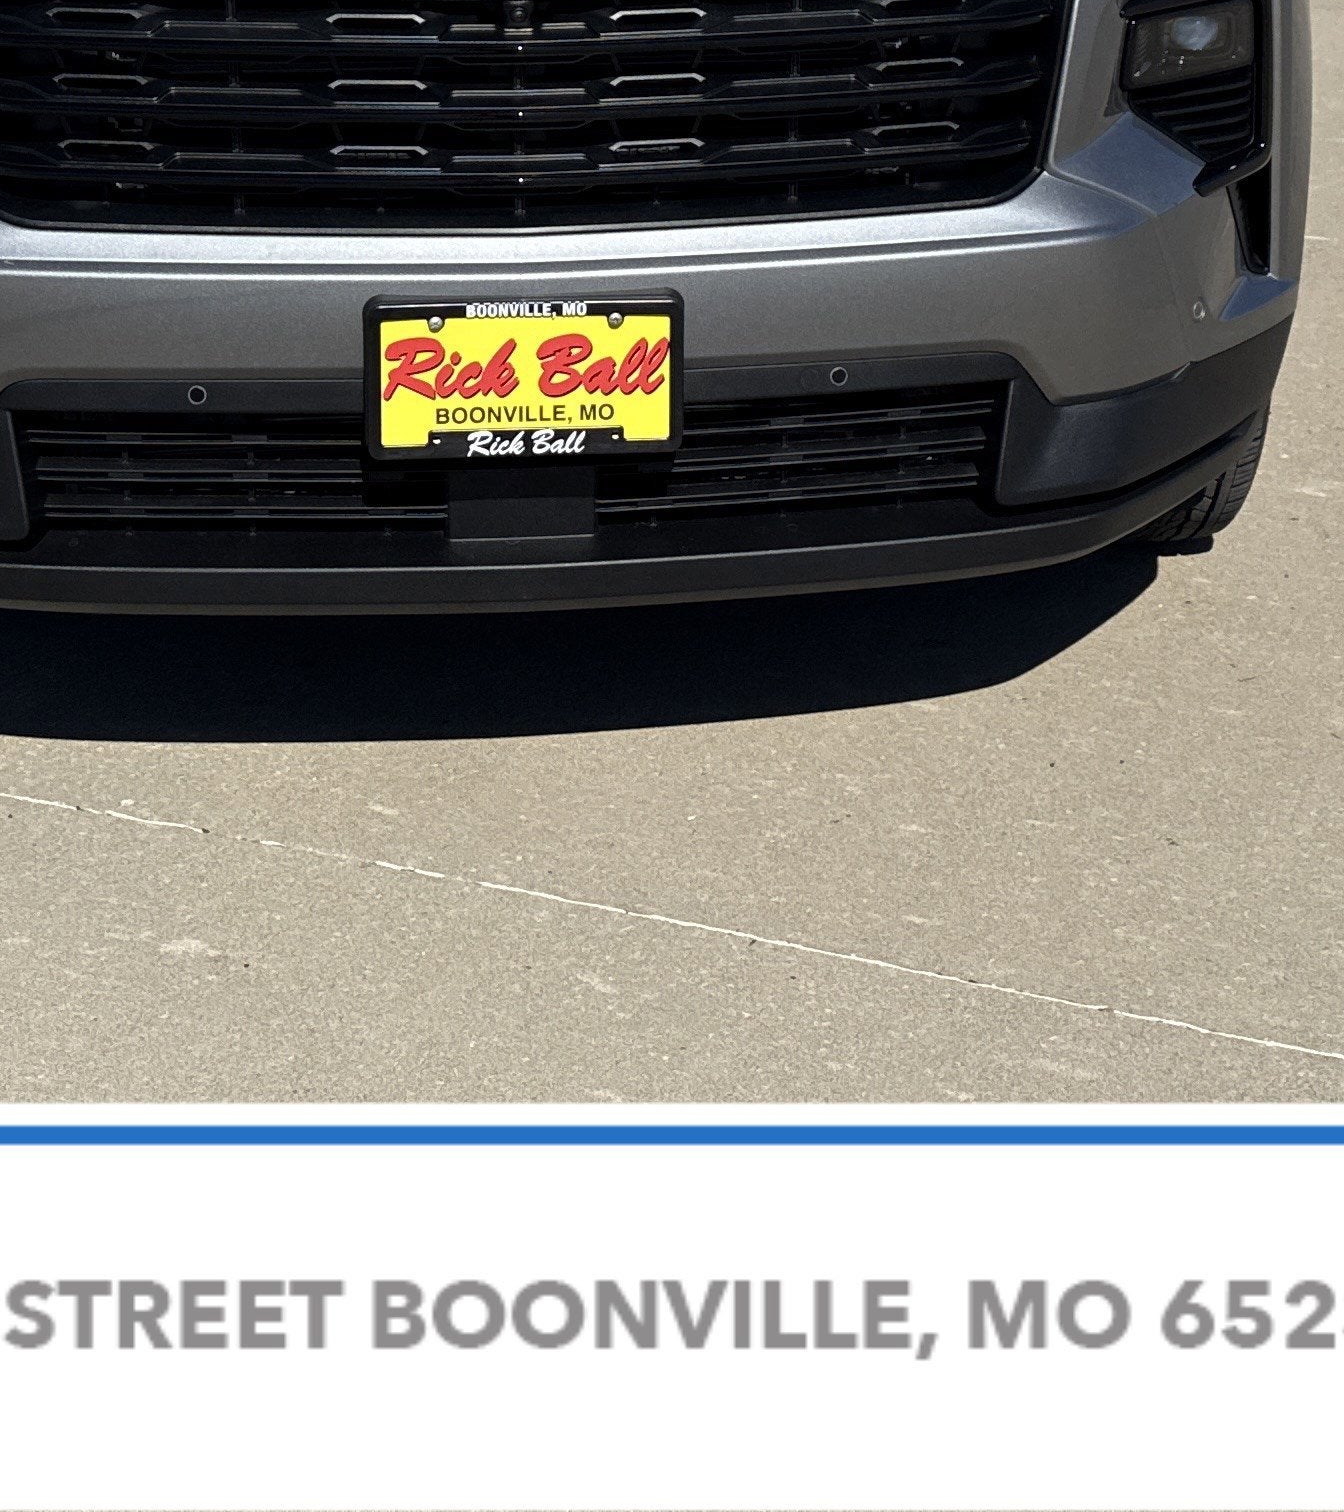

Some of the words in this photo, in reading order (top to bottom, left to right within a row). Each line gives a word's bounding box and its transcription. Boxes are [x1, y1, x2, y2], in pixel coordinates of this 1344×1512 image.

[466, 302, 557, 320] BOONVILLE,
[562, 302, 587, 317] MO
[383, 337, 520, 401] Rick
[536, 333, 670, 398] Ball
[436, 405, 573, 425] BOONVILLE,
[579, 403, 615, 421] MO
[467, 431, 526, 458] Rick
[532, 430, 585, 456] Ball
